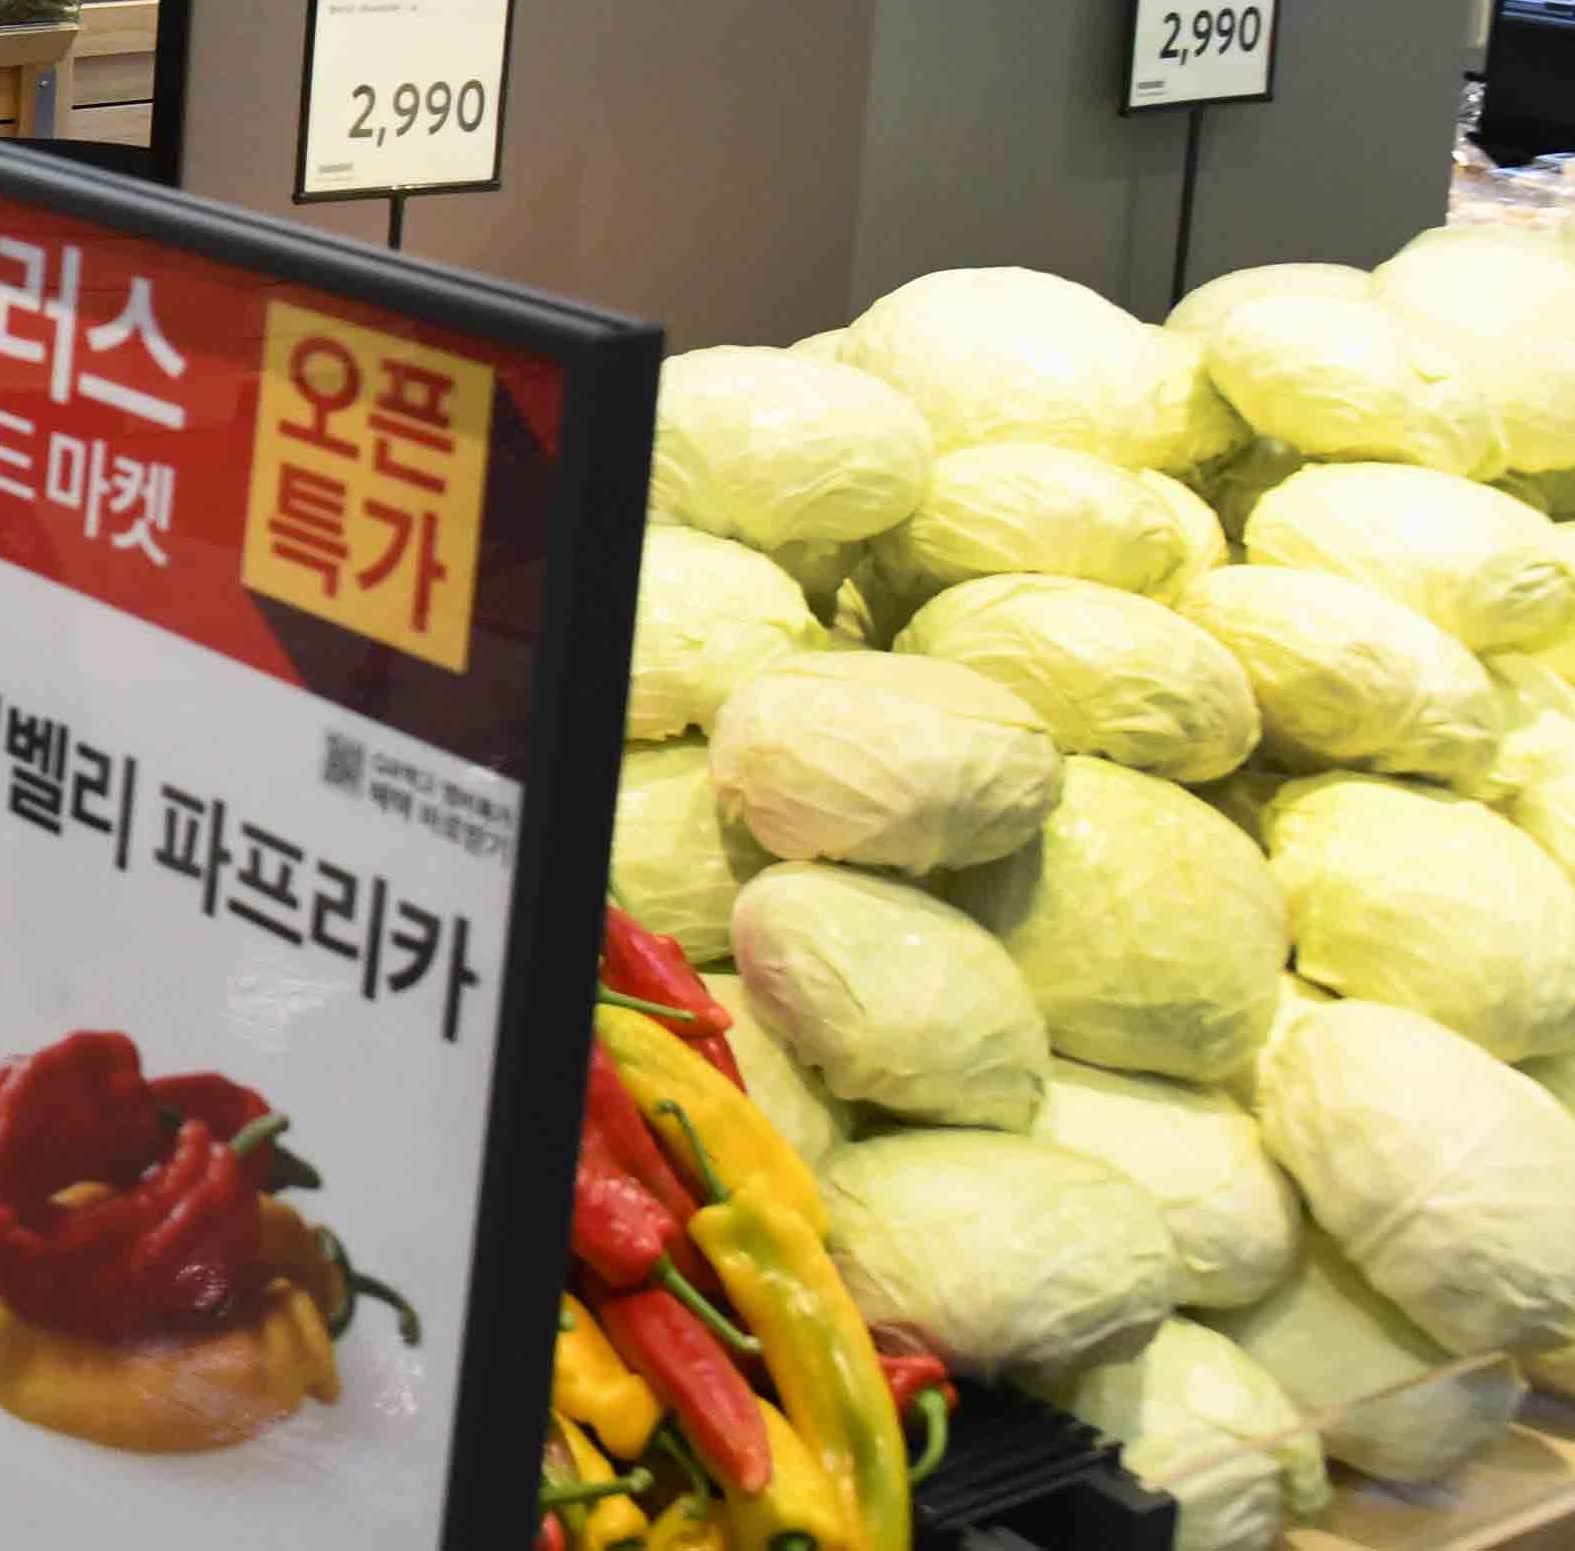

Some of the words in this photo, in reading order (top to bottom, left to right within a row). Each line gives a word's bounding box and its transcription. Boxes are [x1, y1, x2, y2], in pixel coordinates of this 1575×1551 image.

[1158, 5, 1263, 67] 2,990
[347, 78, 487, 148] 2,990
[276, 333, 459, 496] 오픈
[44, 435, 176, 569] 마켓
[266, 463, 450, 637] 특가
[154, 779, 481, 1046] 파프리카
